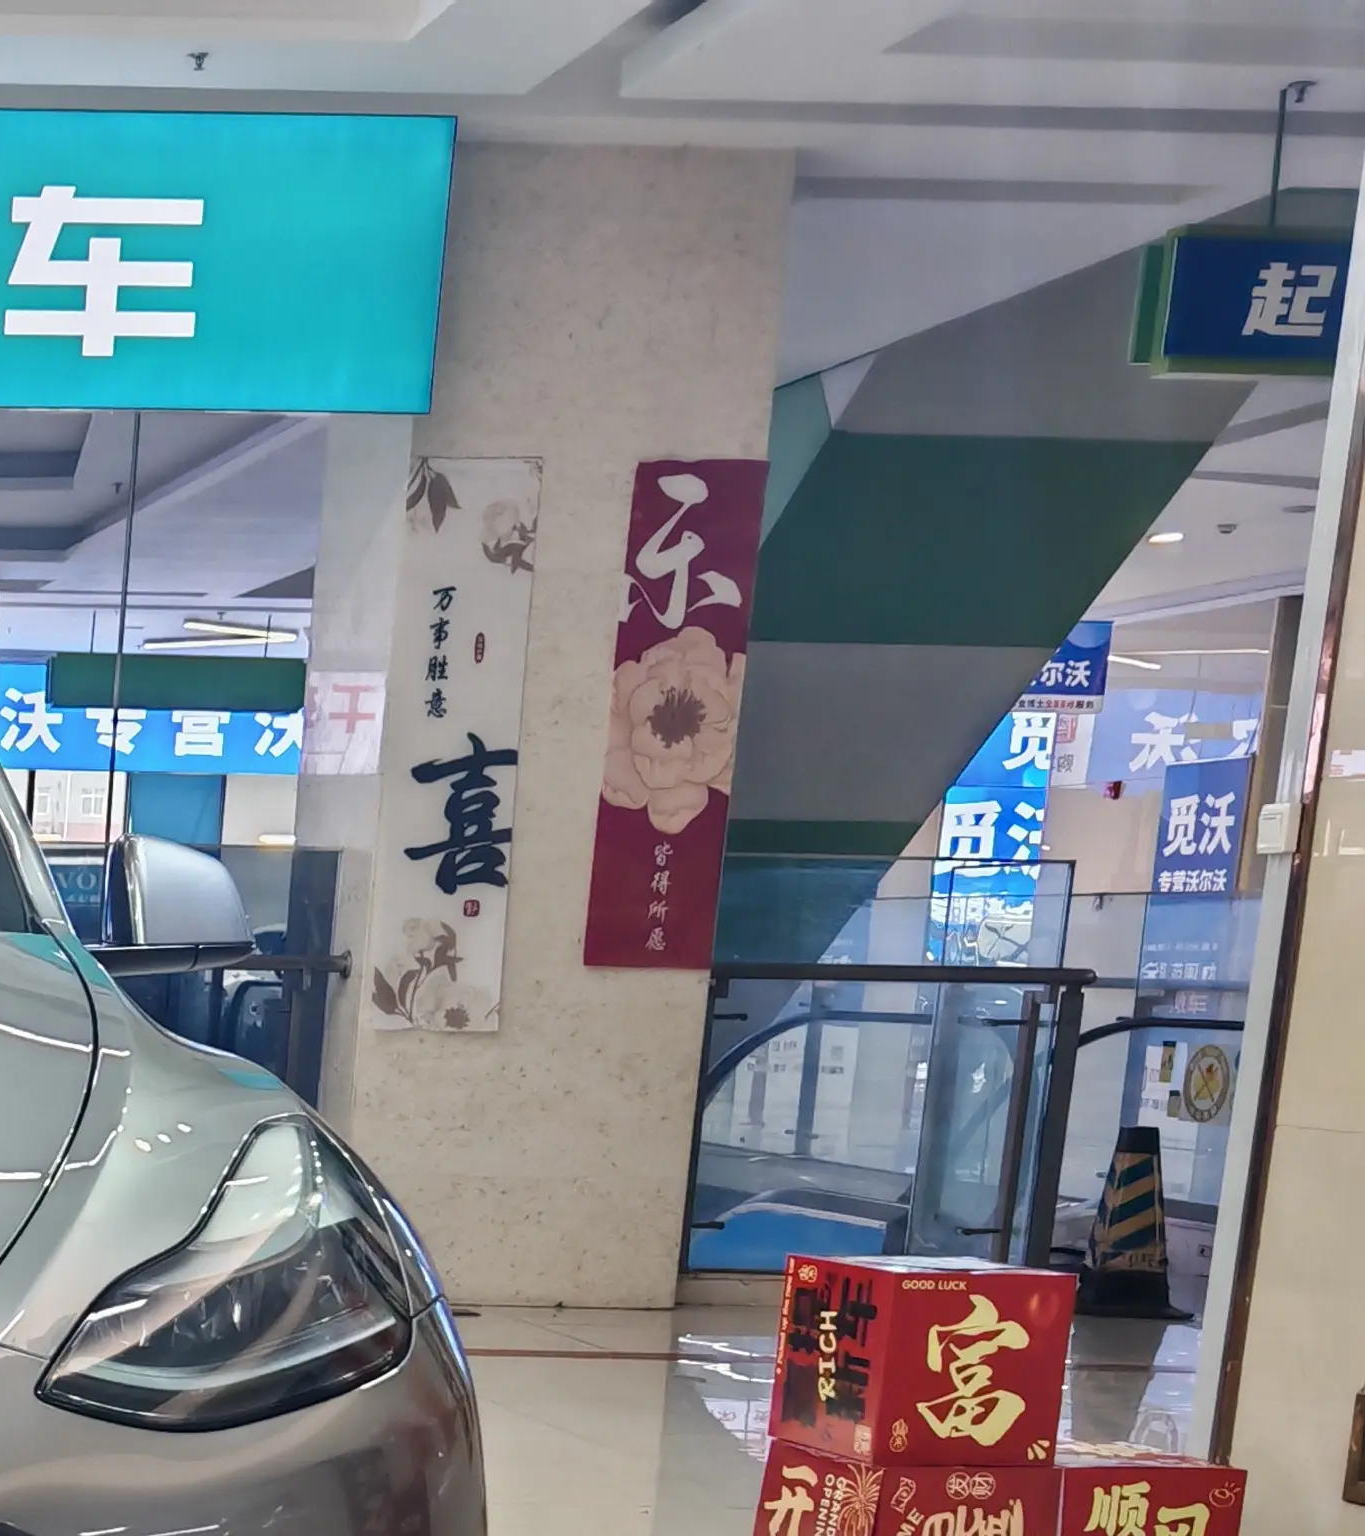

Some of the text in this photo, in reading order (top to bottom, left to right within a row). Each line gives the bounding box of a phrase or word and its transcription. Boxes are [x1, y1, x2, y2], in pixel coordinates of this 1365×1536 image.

[1242, 262, 1338, 338] 起
[618, 473, 743, 630] 乐
[424, 585, 458, 719] 万事胜意
[1030, 659, 1092, 688] 尔沃
[403, 731, 519, 895] 喜
[1162, 791, 1237, 858] 觅沃
[644, 841, 674, 952] 皆得所愿
[1157, 868, 1228, 894] 专营沃尔沃
[902, 1279, 968, 1291] GOOD LUCK
[817, 1309, 839, 1403] RICH
[915, 1293, 1031, 1447] 富
